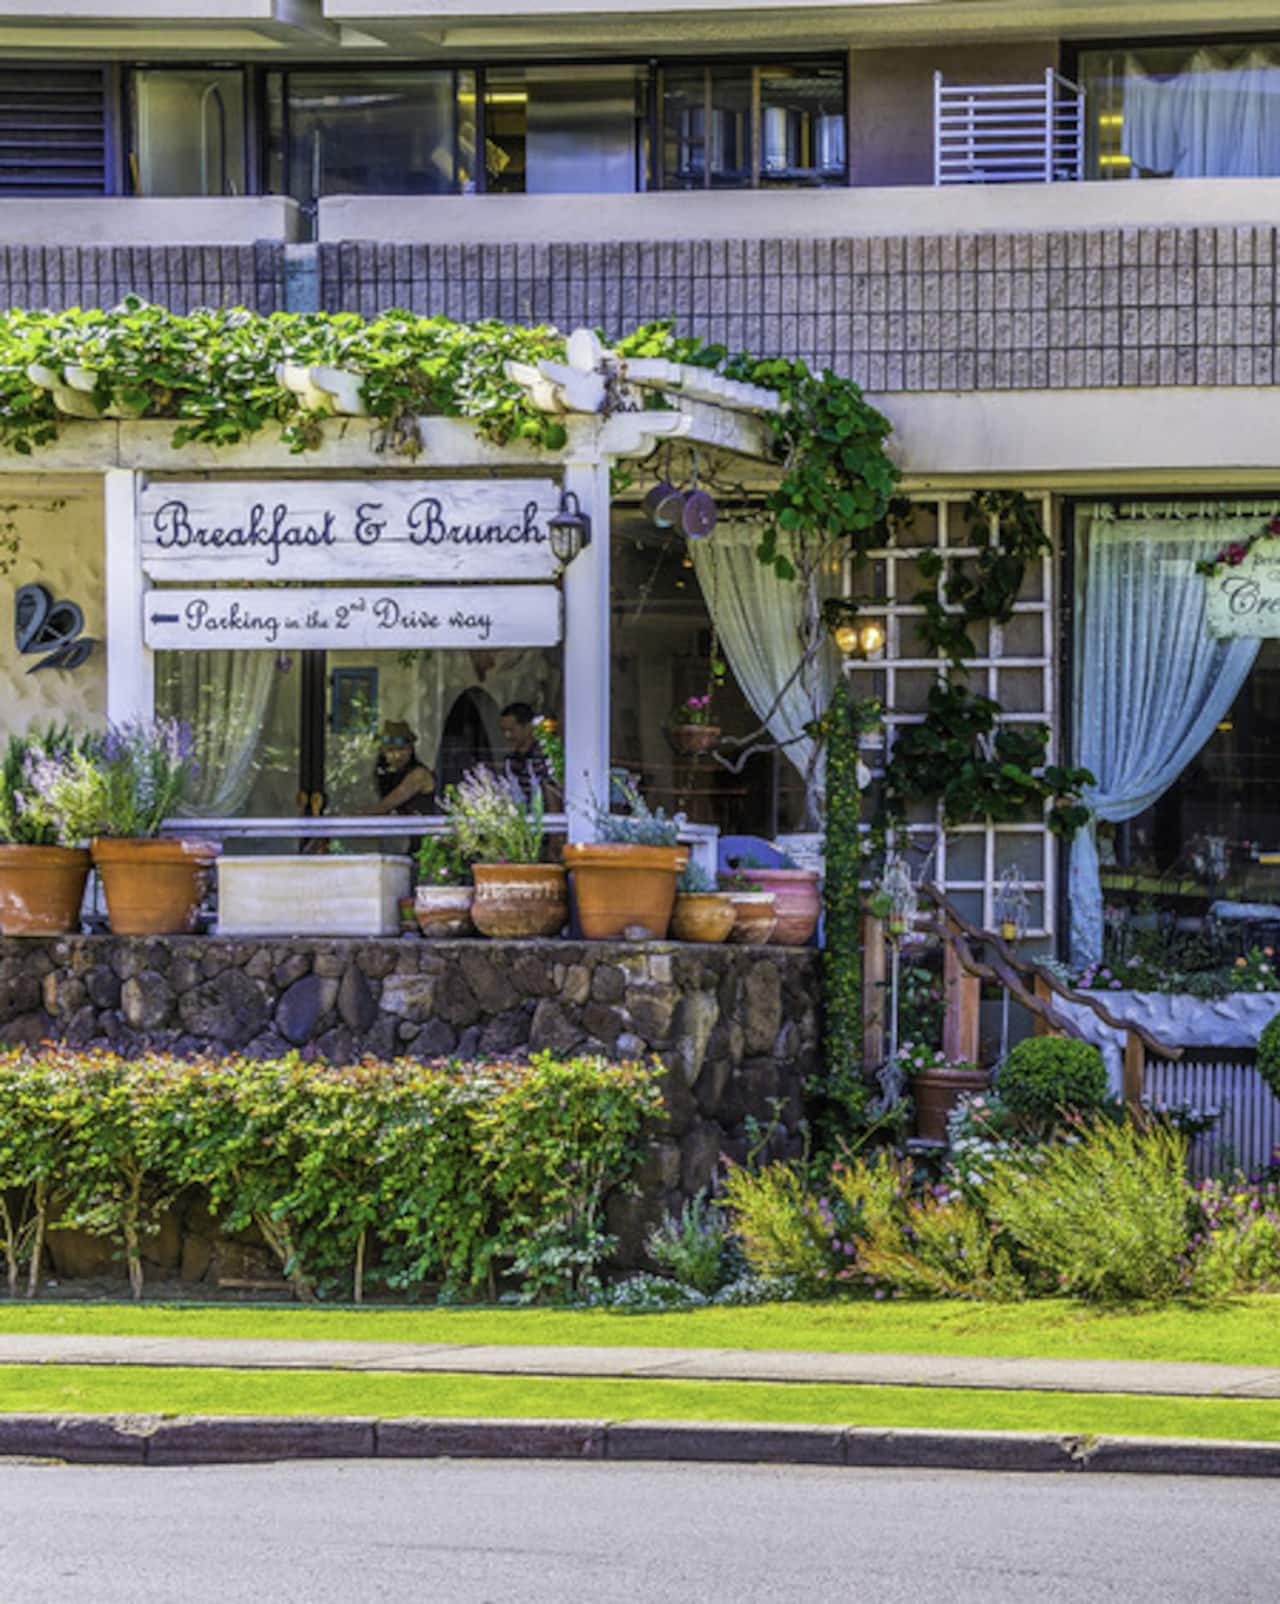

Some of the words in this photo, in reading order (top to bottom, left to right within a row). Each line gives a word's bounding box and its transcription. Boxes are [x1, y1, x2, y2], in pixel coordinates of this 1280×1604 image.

[154, 500, 337, 565] Breakfast
[355, 502, 388, 545] &
[407, 498, 546, 546] Brunch
[185, 599, 281, 643] Parking
[285, 614, 300, 630] in
[306, 609, 329, 630] the
[335, 597, 366, 630] 2nd
